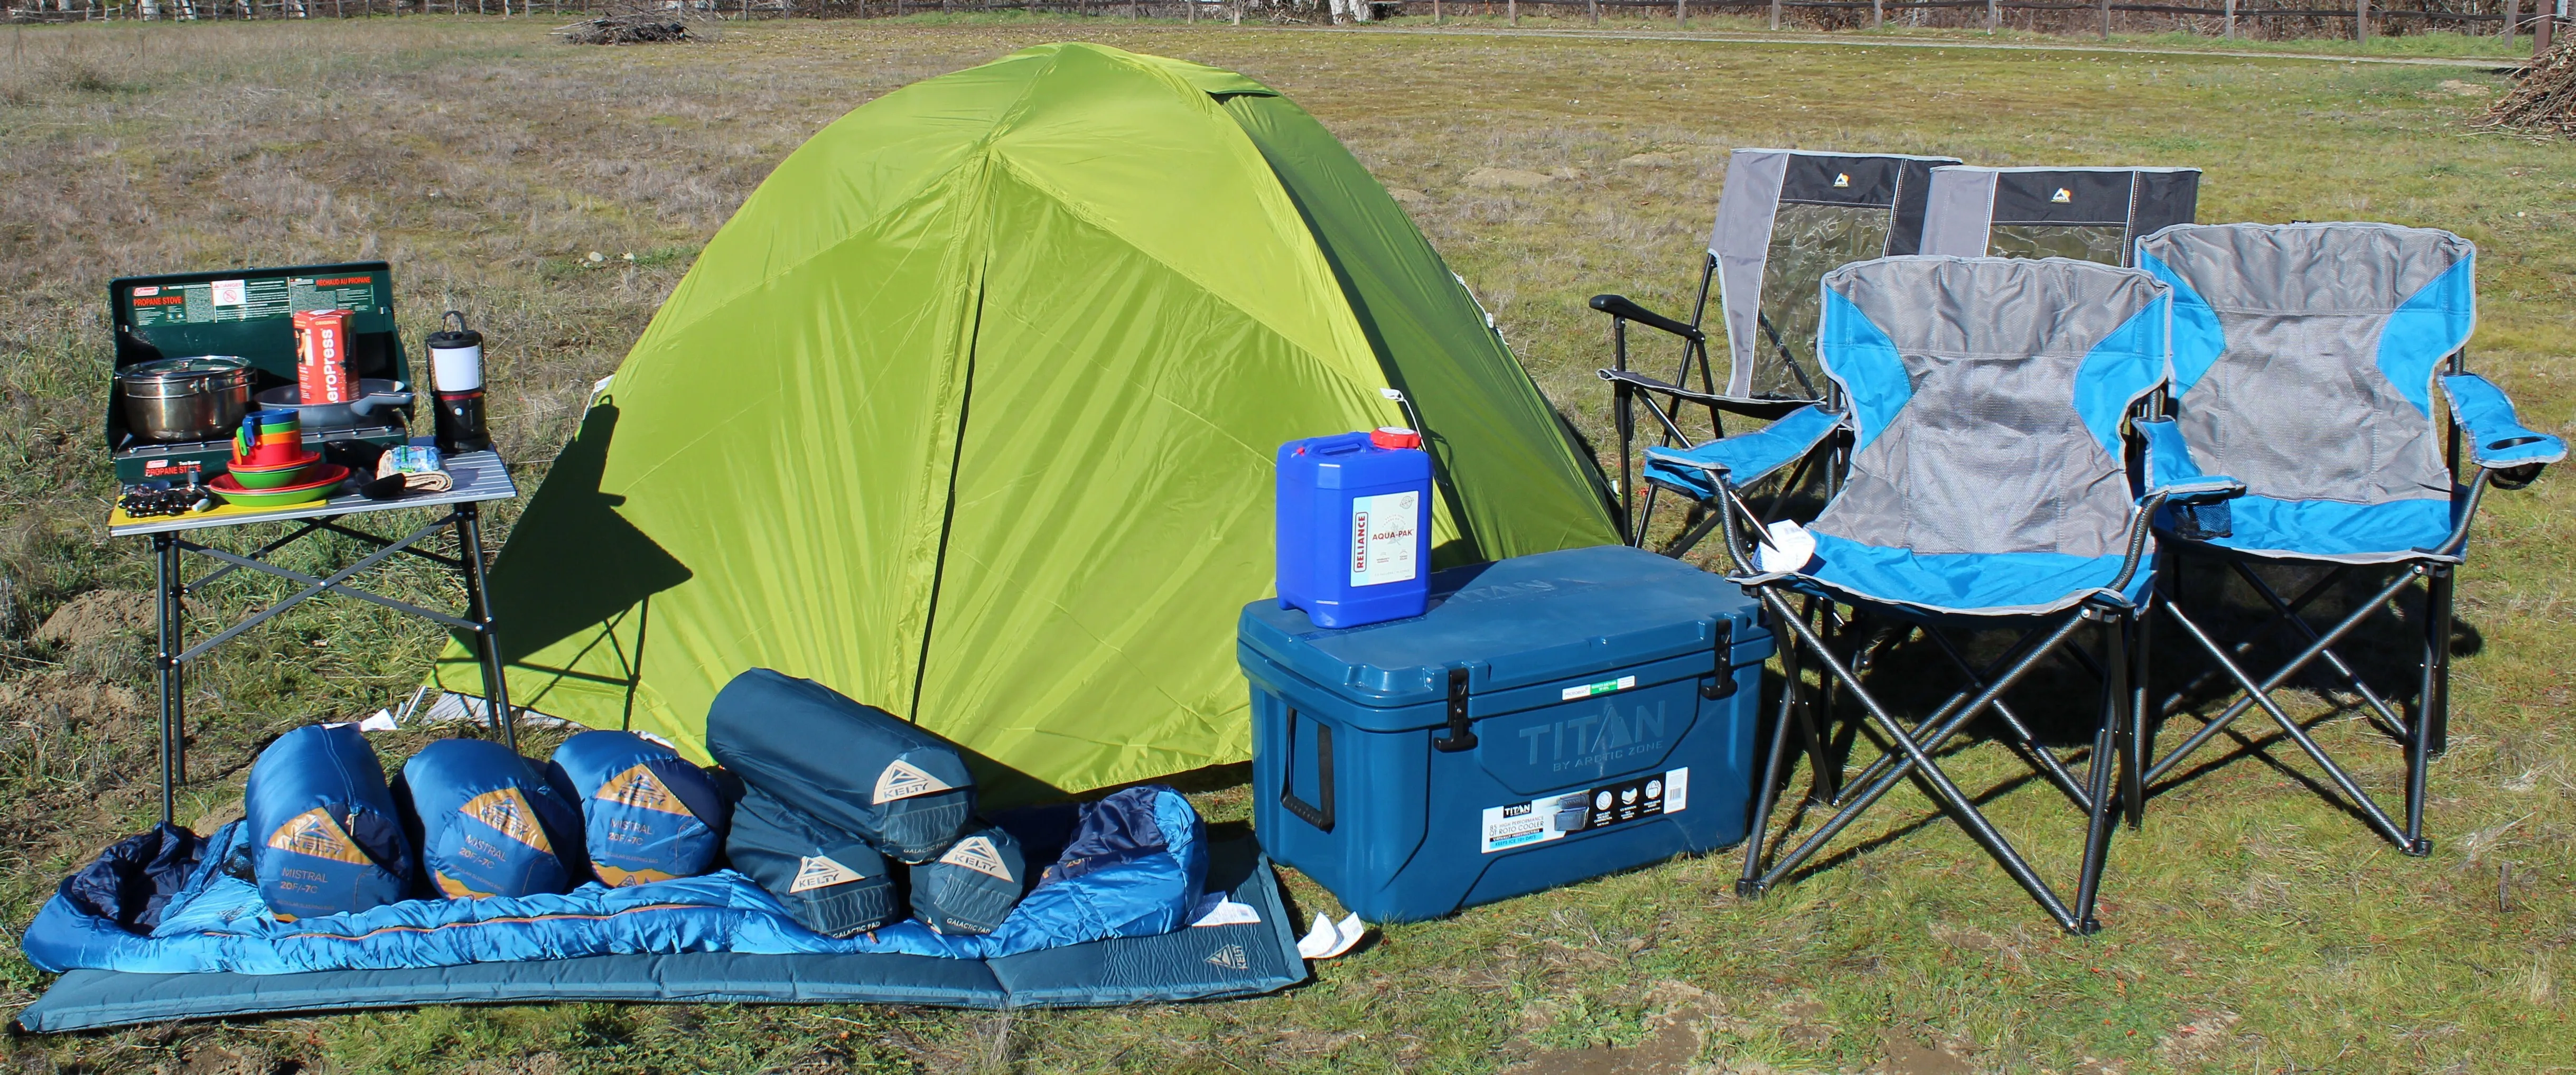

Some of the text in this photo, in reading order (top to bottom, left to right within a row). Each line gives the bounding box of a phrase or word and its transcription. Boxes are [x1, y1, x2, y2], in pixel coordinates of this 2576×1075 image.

[134, 296, 183, 306] PROPANE STOVE
[145, 465, 201, 476] PROPANE STE
[1372, 529, 1413, 540] AQUA-PAK
[1356, 516, 1366, 569] RELIANCE
[1519, 700, 1665, 765] TITAN
[1553, 740, 1664, 772] BY ARCTIC ZONE
[884, 782, 929, 799] KELTY
[1505, 804, 1530, 815] TITAN
[610, 818, 652, 835] MISTRAL
[1499, 826, 1516, 835] ROTO
[1518, 820, 1544, 831] COOLER
[1511, 816, 1544, 826] PERFORMANCE
[608, 833, 644, 845] 20F/-7C
[465, 834, 507, 862] MISTRAL
[903, 845, 936, 854] GALACTIC
[459, 847, 496, 869] 20F/-7C
[626, 854, 648, 863] SLEEPING
[955, 854, 997, 871] KELTY
[282, 867, 328, 883] MISTRAL
[799, 873, 840, 887] KELTY
[280, 881, 318, 893] 20F/-7C
[833, 921, 881, 939] GALACTIC PAD
[947, 918, 977, 931] GALACTIC
